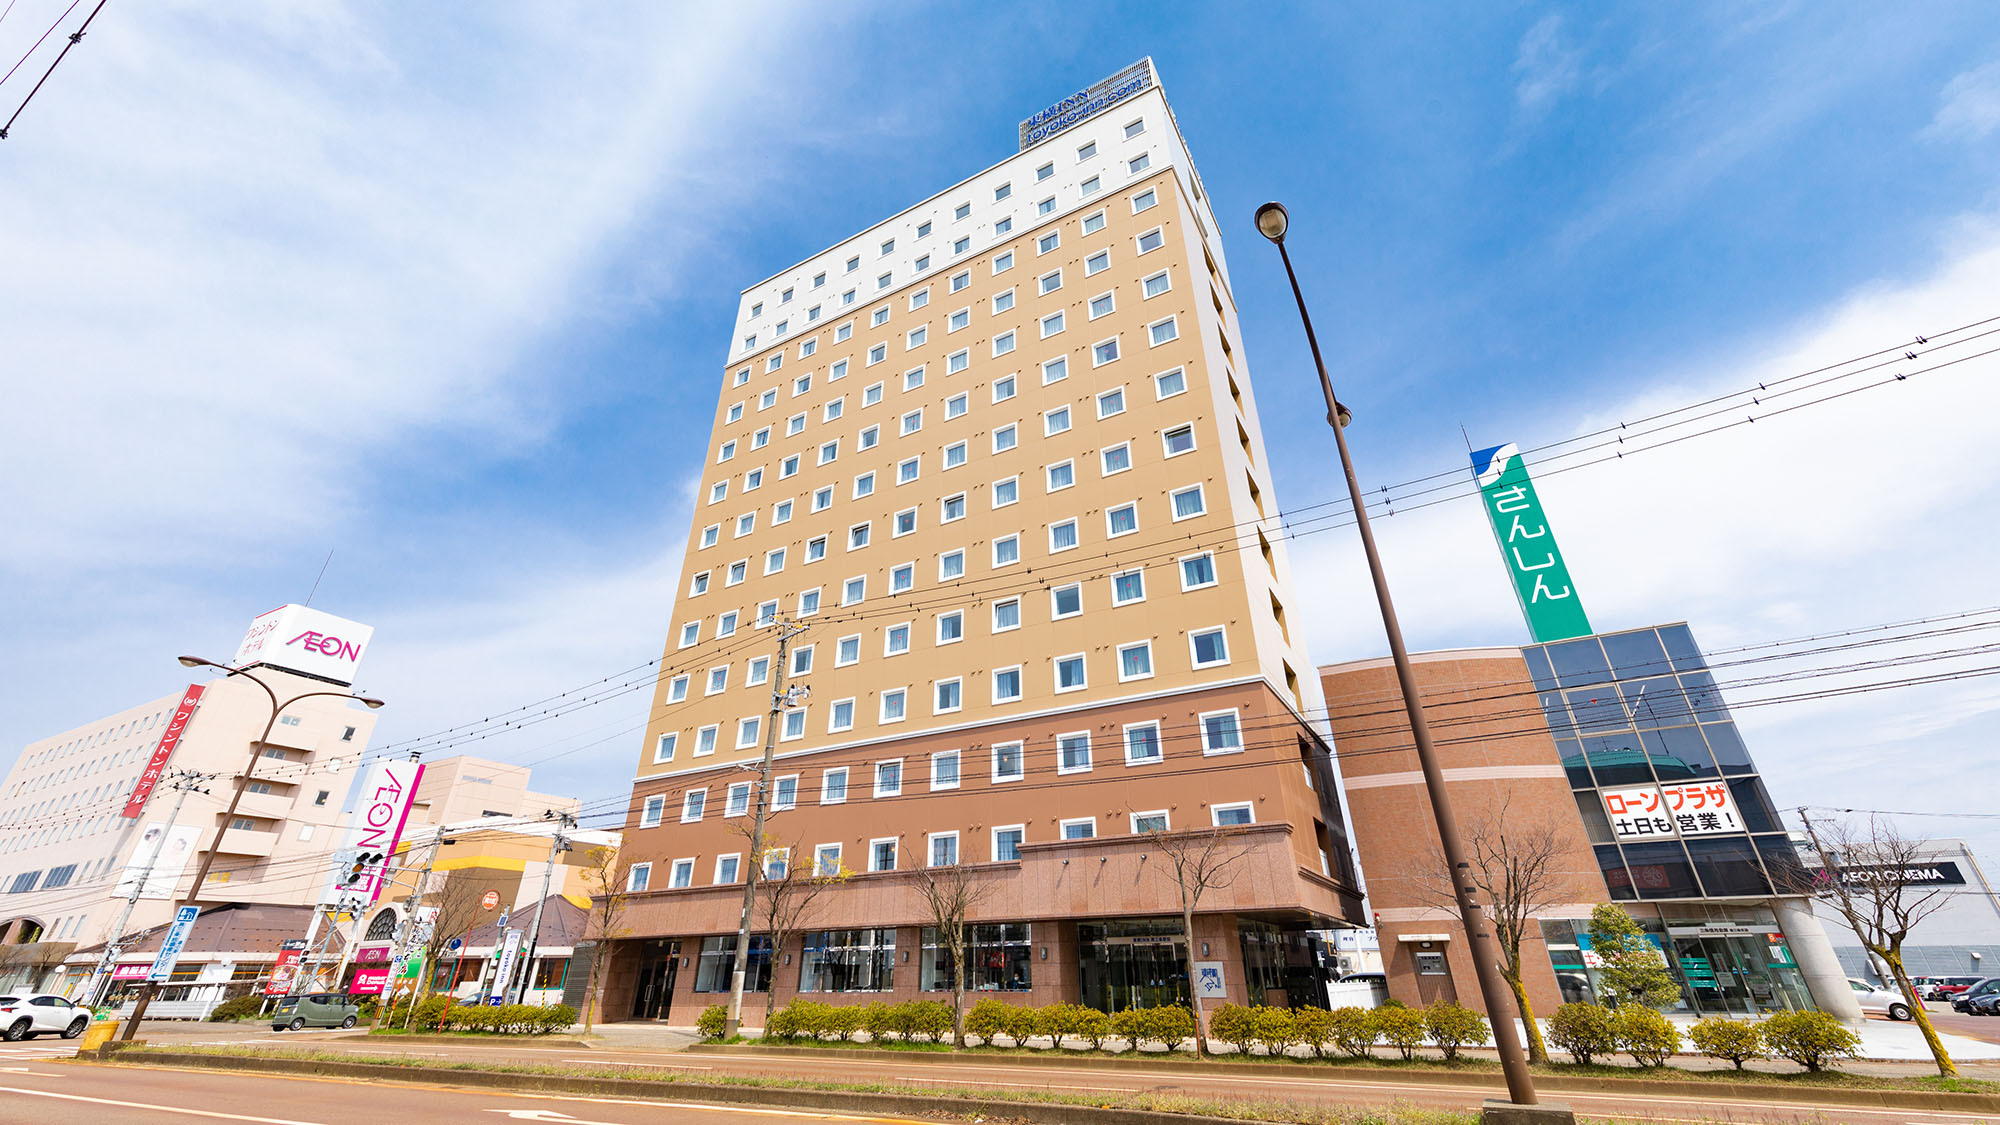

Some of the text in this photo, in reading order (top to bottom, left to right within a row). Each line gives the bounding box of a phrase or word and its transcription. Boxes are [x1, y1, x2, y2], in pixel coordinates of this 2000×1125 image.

[1028, 79, 1142, 143] toyoko-inn.com
[1492, 485, 1570, 604] さんしん
[246, 620, 279, 641] ワシントン
[286, 630, 361, 662] AEON
[131, 711, 189, 804] ワシントンホテル
[1605, 783, 1726, 815] ローンプラザ
[1616, 812, 1735, 836] 土日も営業！
[1884, 868, 1945, 881] CINEMA
[501, 949, 513, 973] toyoko
[489, 998, 496, 1006] P
